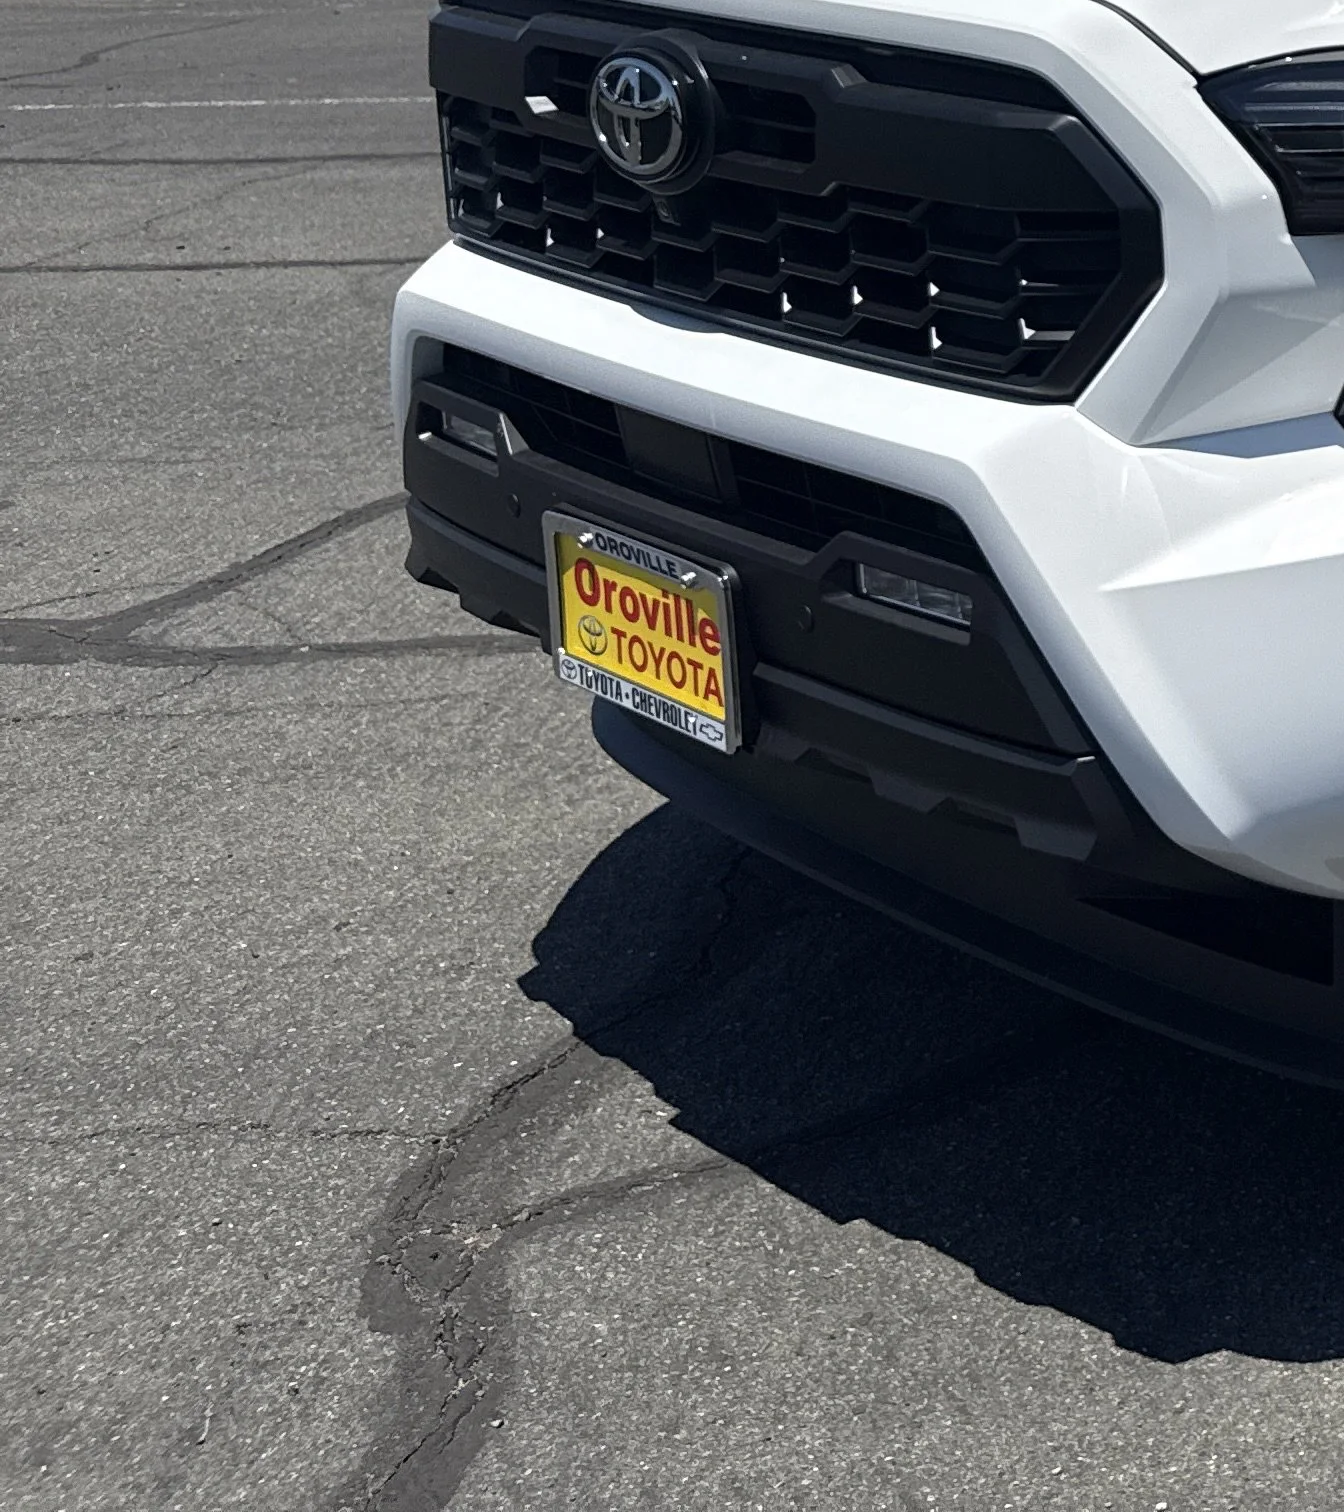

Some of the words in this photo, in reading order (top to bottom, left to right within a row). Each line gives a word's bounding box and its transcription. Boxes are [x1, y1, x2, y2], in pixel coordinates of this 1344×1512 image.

[595, 531, 680, 580] OROVILLE
[574, 557, 722, 656] Oroville
[577, 662, 624, 703] TOYOTA
[631, 687, 700, 737] CHEVROLET
[610, 626, 724, 708] TOYOTA
